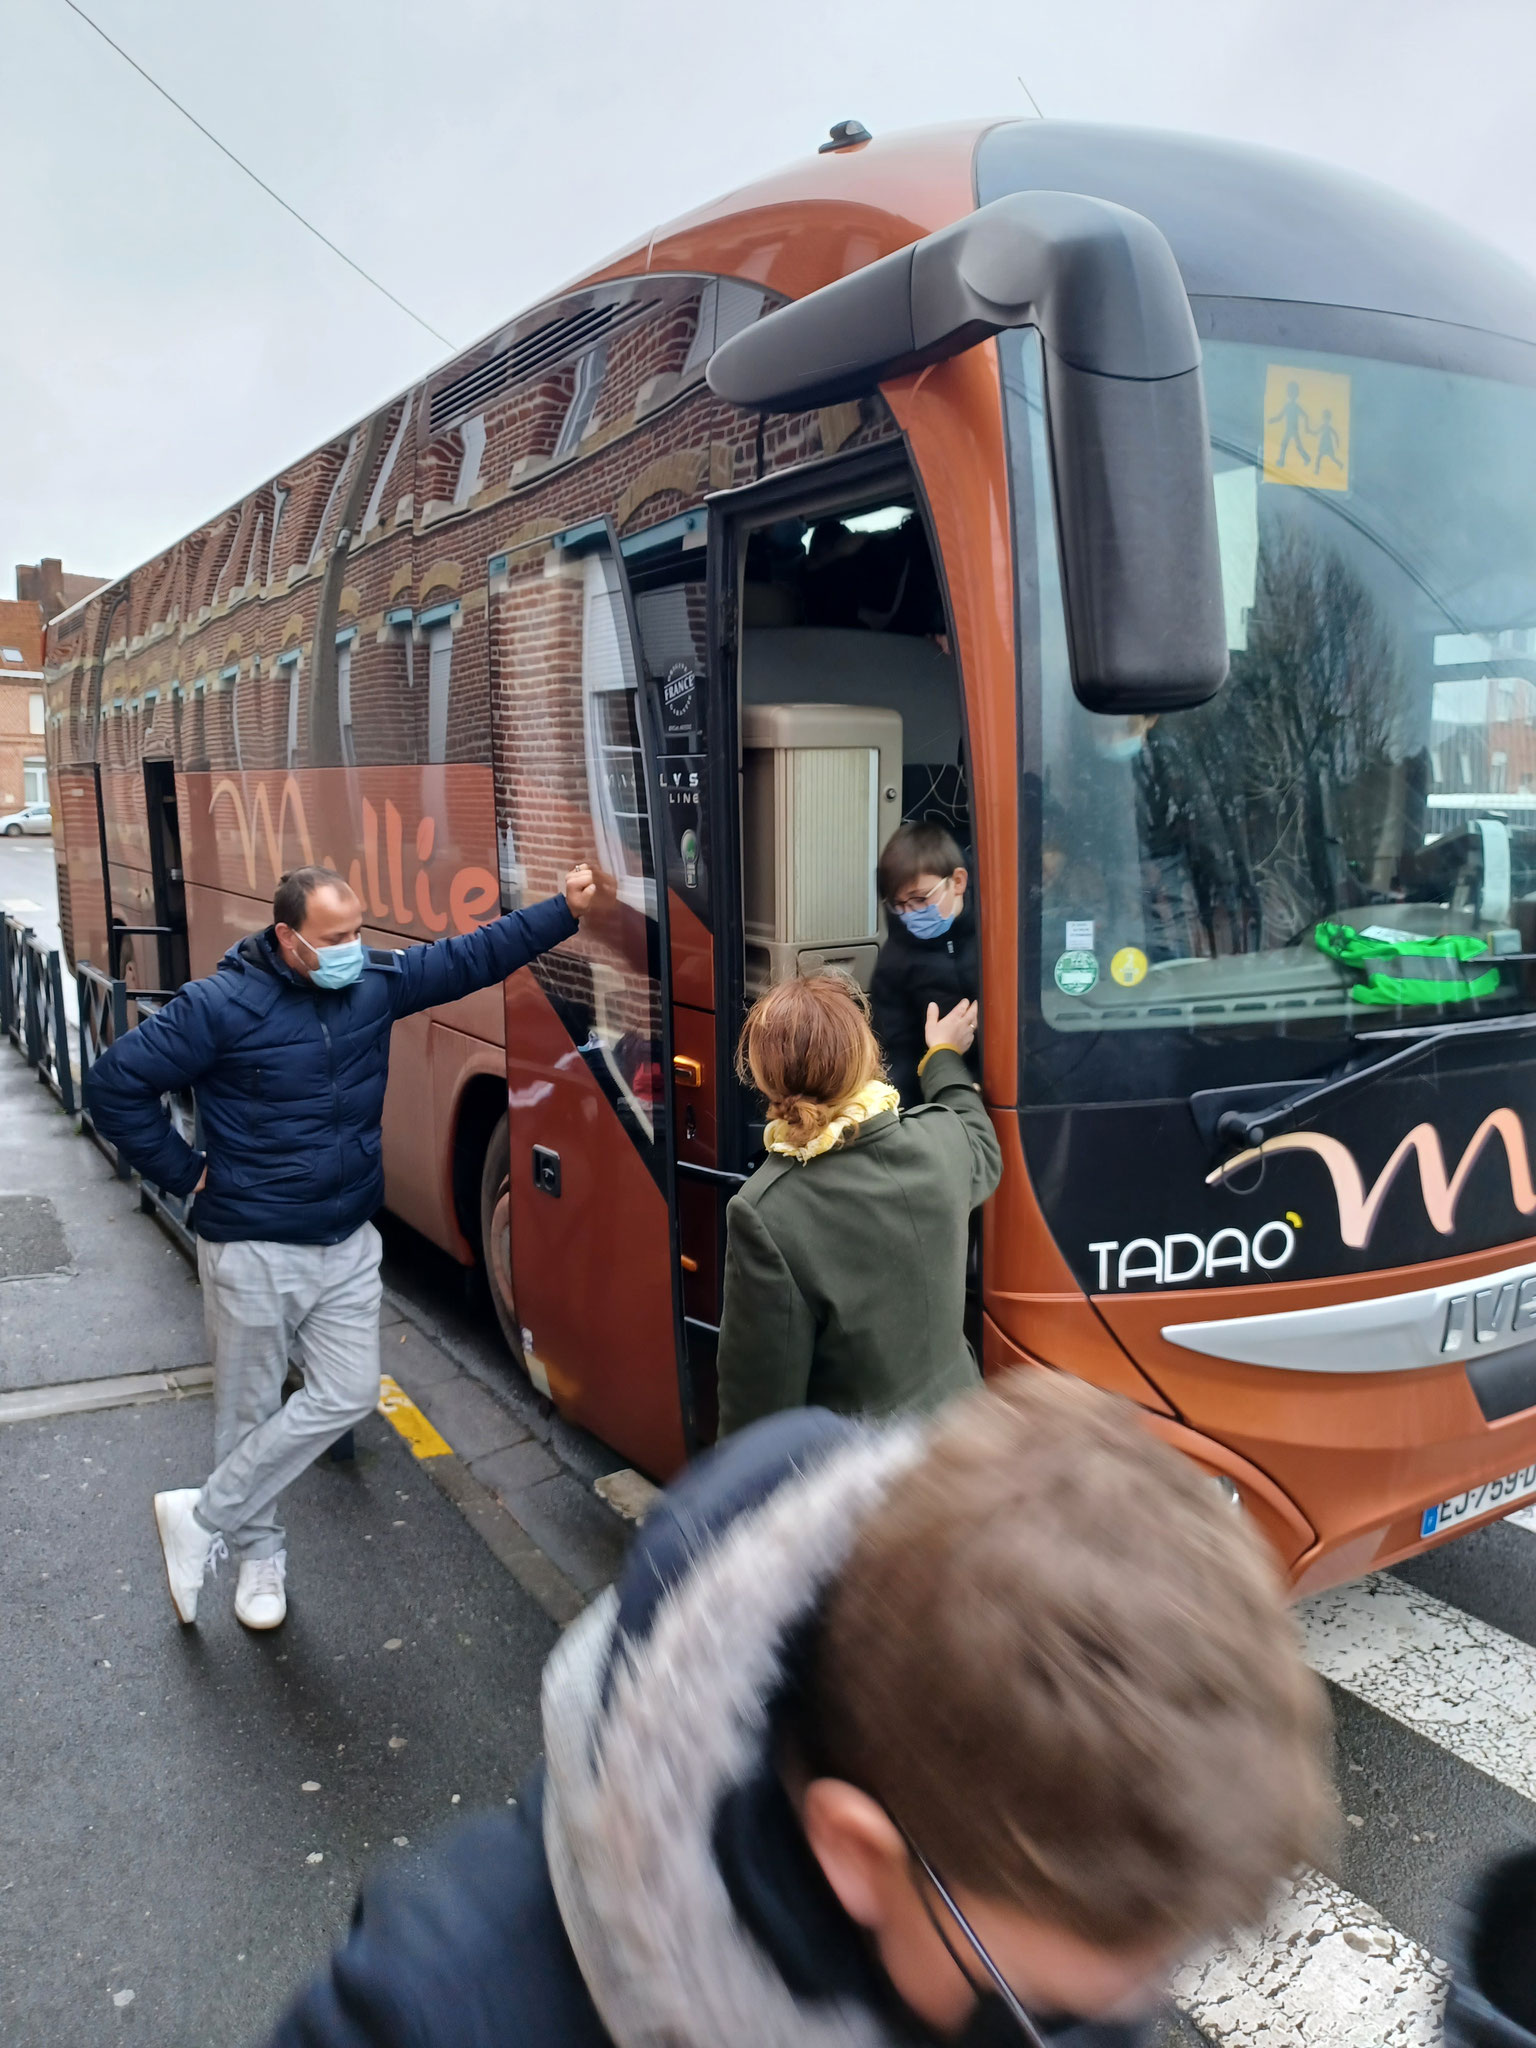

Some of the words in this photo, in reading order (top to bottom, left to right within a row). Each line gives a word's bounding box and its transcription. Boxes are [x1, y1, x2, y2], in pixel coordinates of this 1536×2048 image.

[664, 673, 696, 701] FRANCE
[669, 793, 699, 803] LINE
[1088, 1220, 1296, 1290] TADAO
